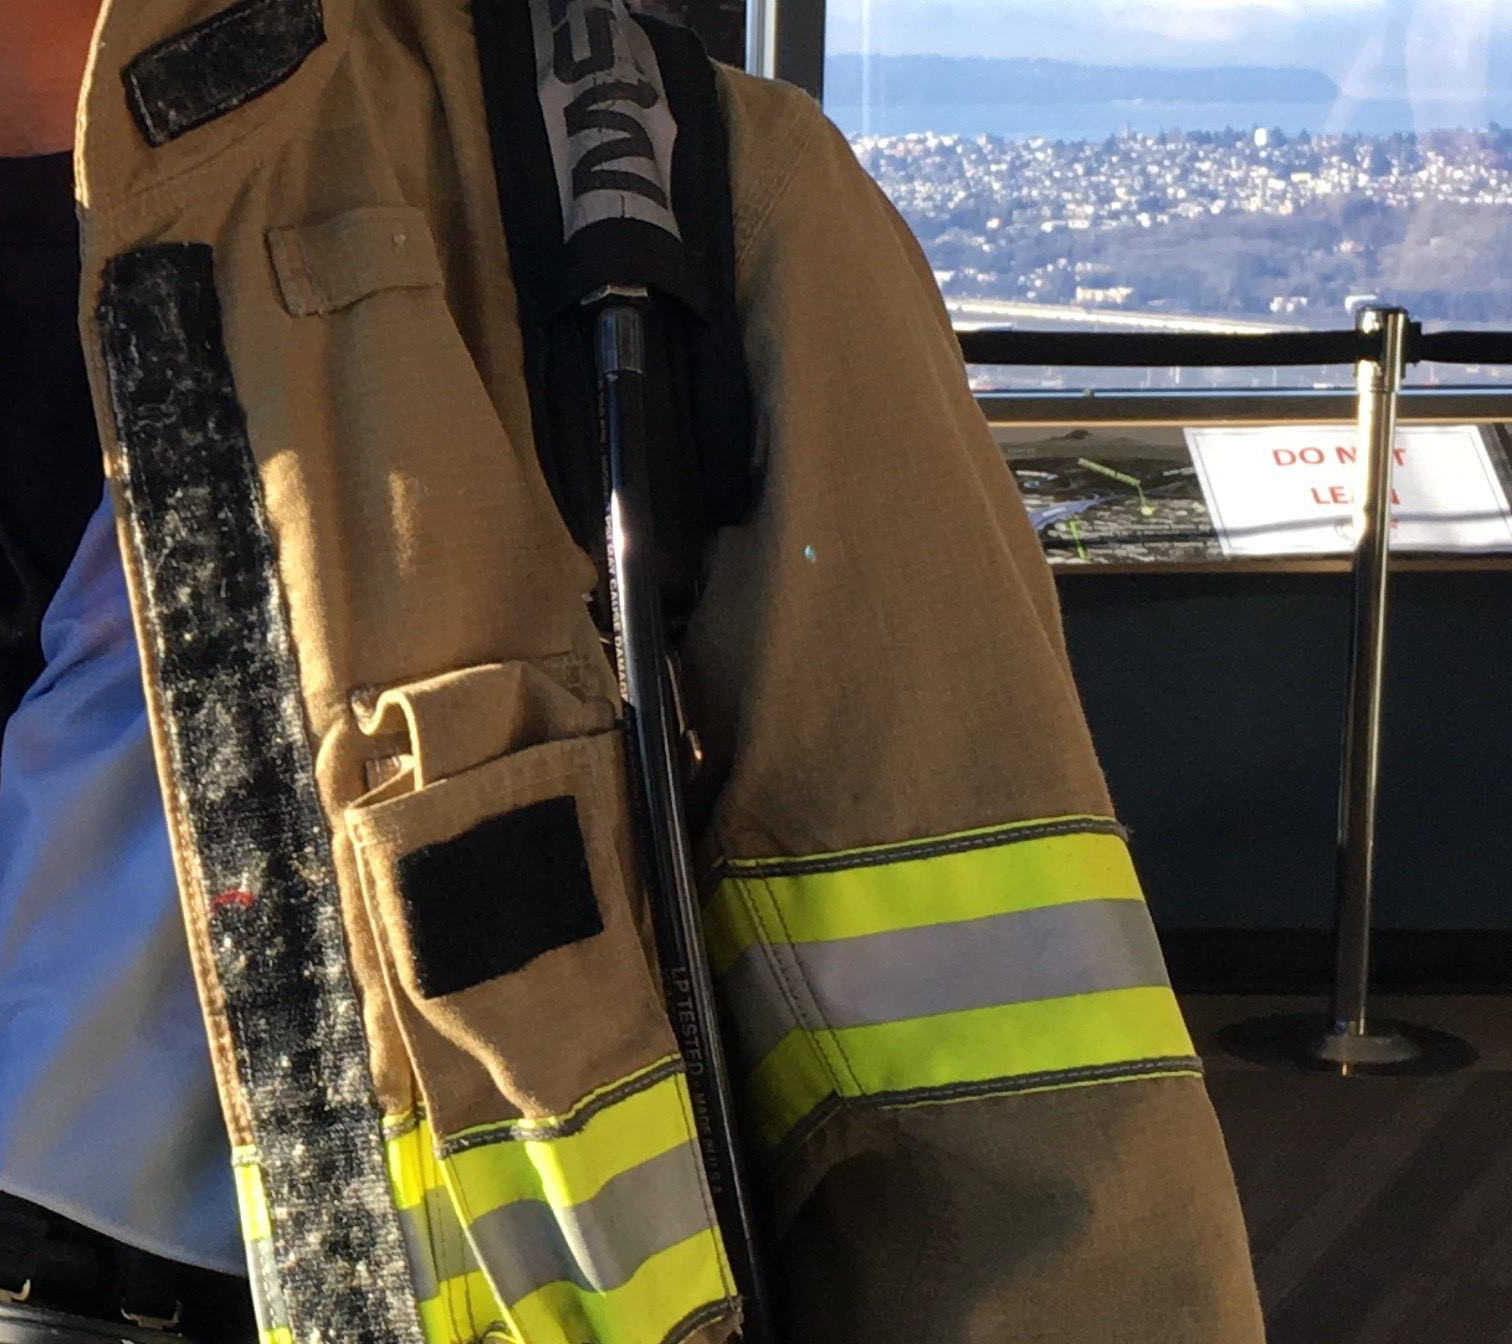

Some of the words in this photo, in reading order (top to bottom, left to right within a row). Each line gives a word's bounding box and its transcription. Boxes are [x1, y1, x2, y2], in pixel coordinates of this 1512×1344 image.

[1272, 447, 1325, 467] DO
[1334, 446, 1406, 467] NT
[1310, 486, 1400, 506] LE
[609, 578, 621, 632] CAUSE
